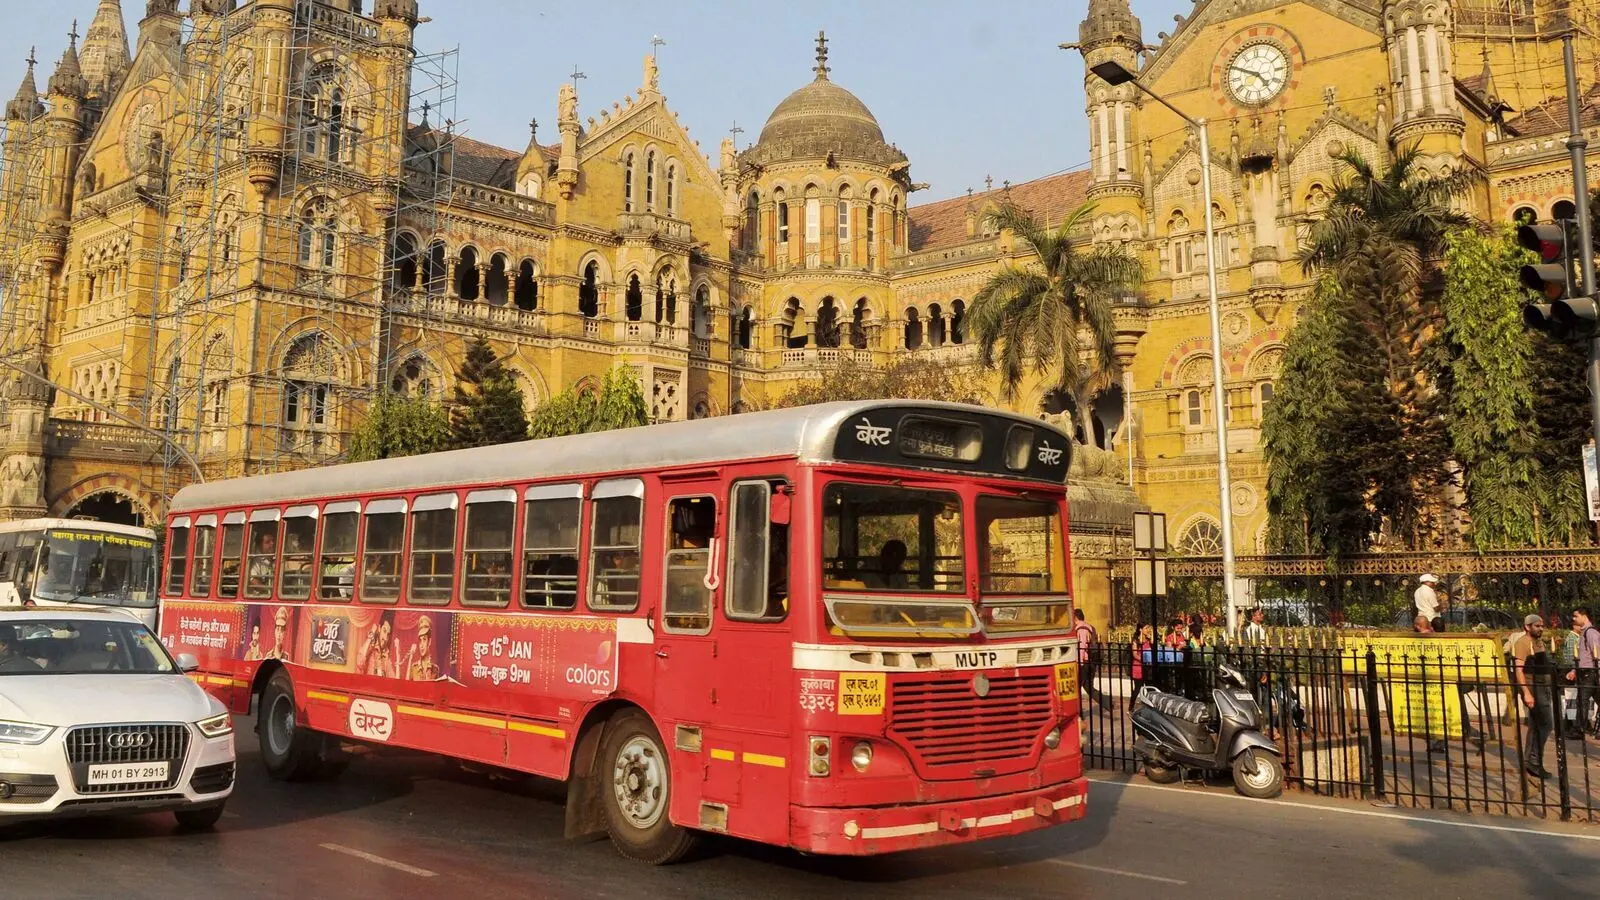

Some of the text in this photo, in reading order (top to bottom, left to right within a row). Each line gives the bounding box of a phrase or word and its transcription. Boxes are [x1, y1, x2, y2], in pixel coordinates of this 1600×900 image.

[855, 417, 893, 446] बेस्ट
[1038, 440, 1063, 465] बेस्ट
[508, 641, 532, 659] JAN
[955, 652, 997, 668] MUTP
[510, 664, 531, 683] 9PM
[566, 663, 610, 687] colors
[800, 678, 835, 694] कुलाबा
[799, 695, 835, 714] २३२५
[354, 704, 388, 736] बेस्ट
[92, 767, 165, 780] MH 01 BY 2913
